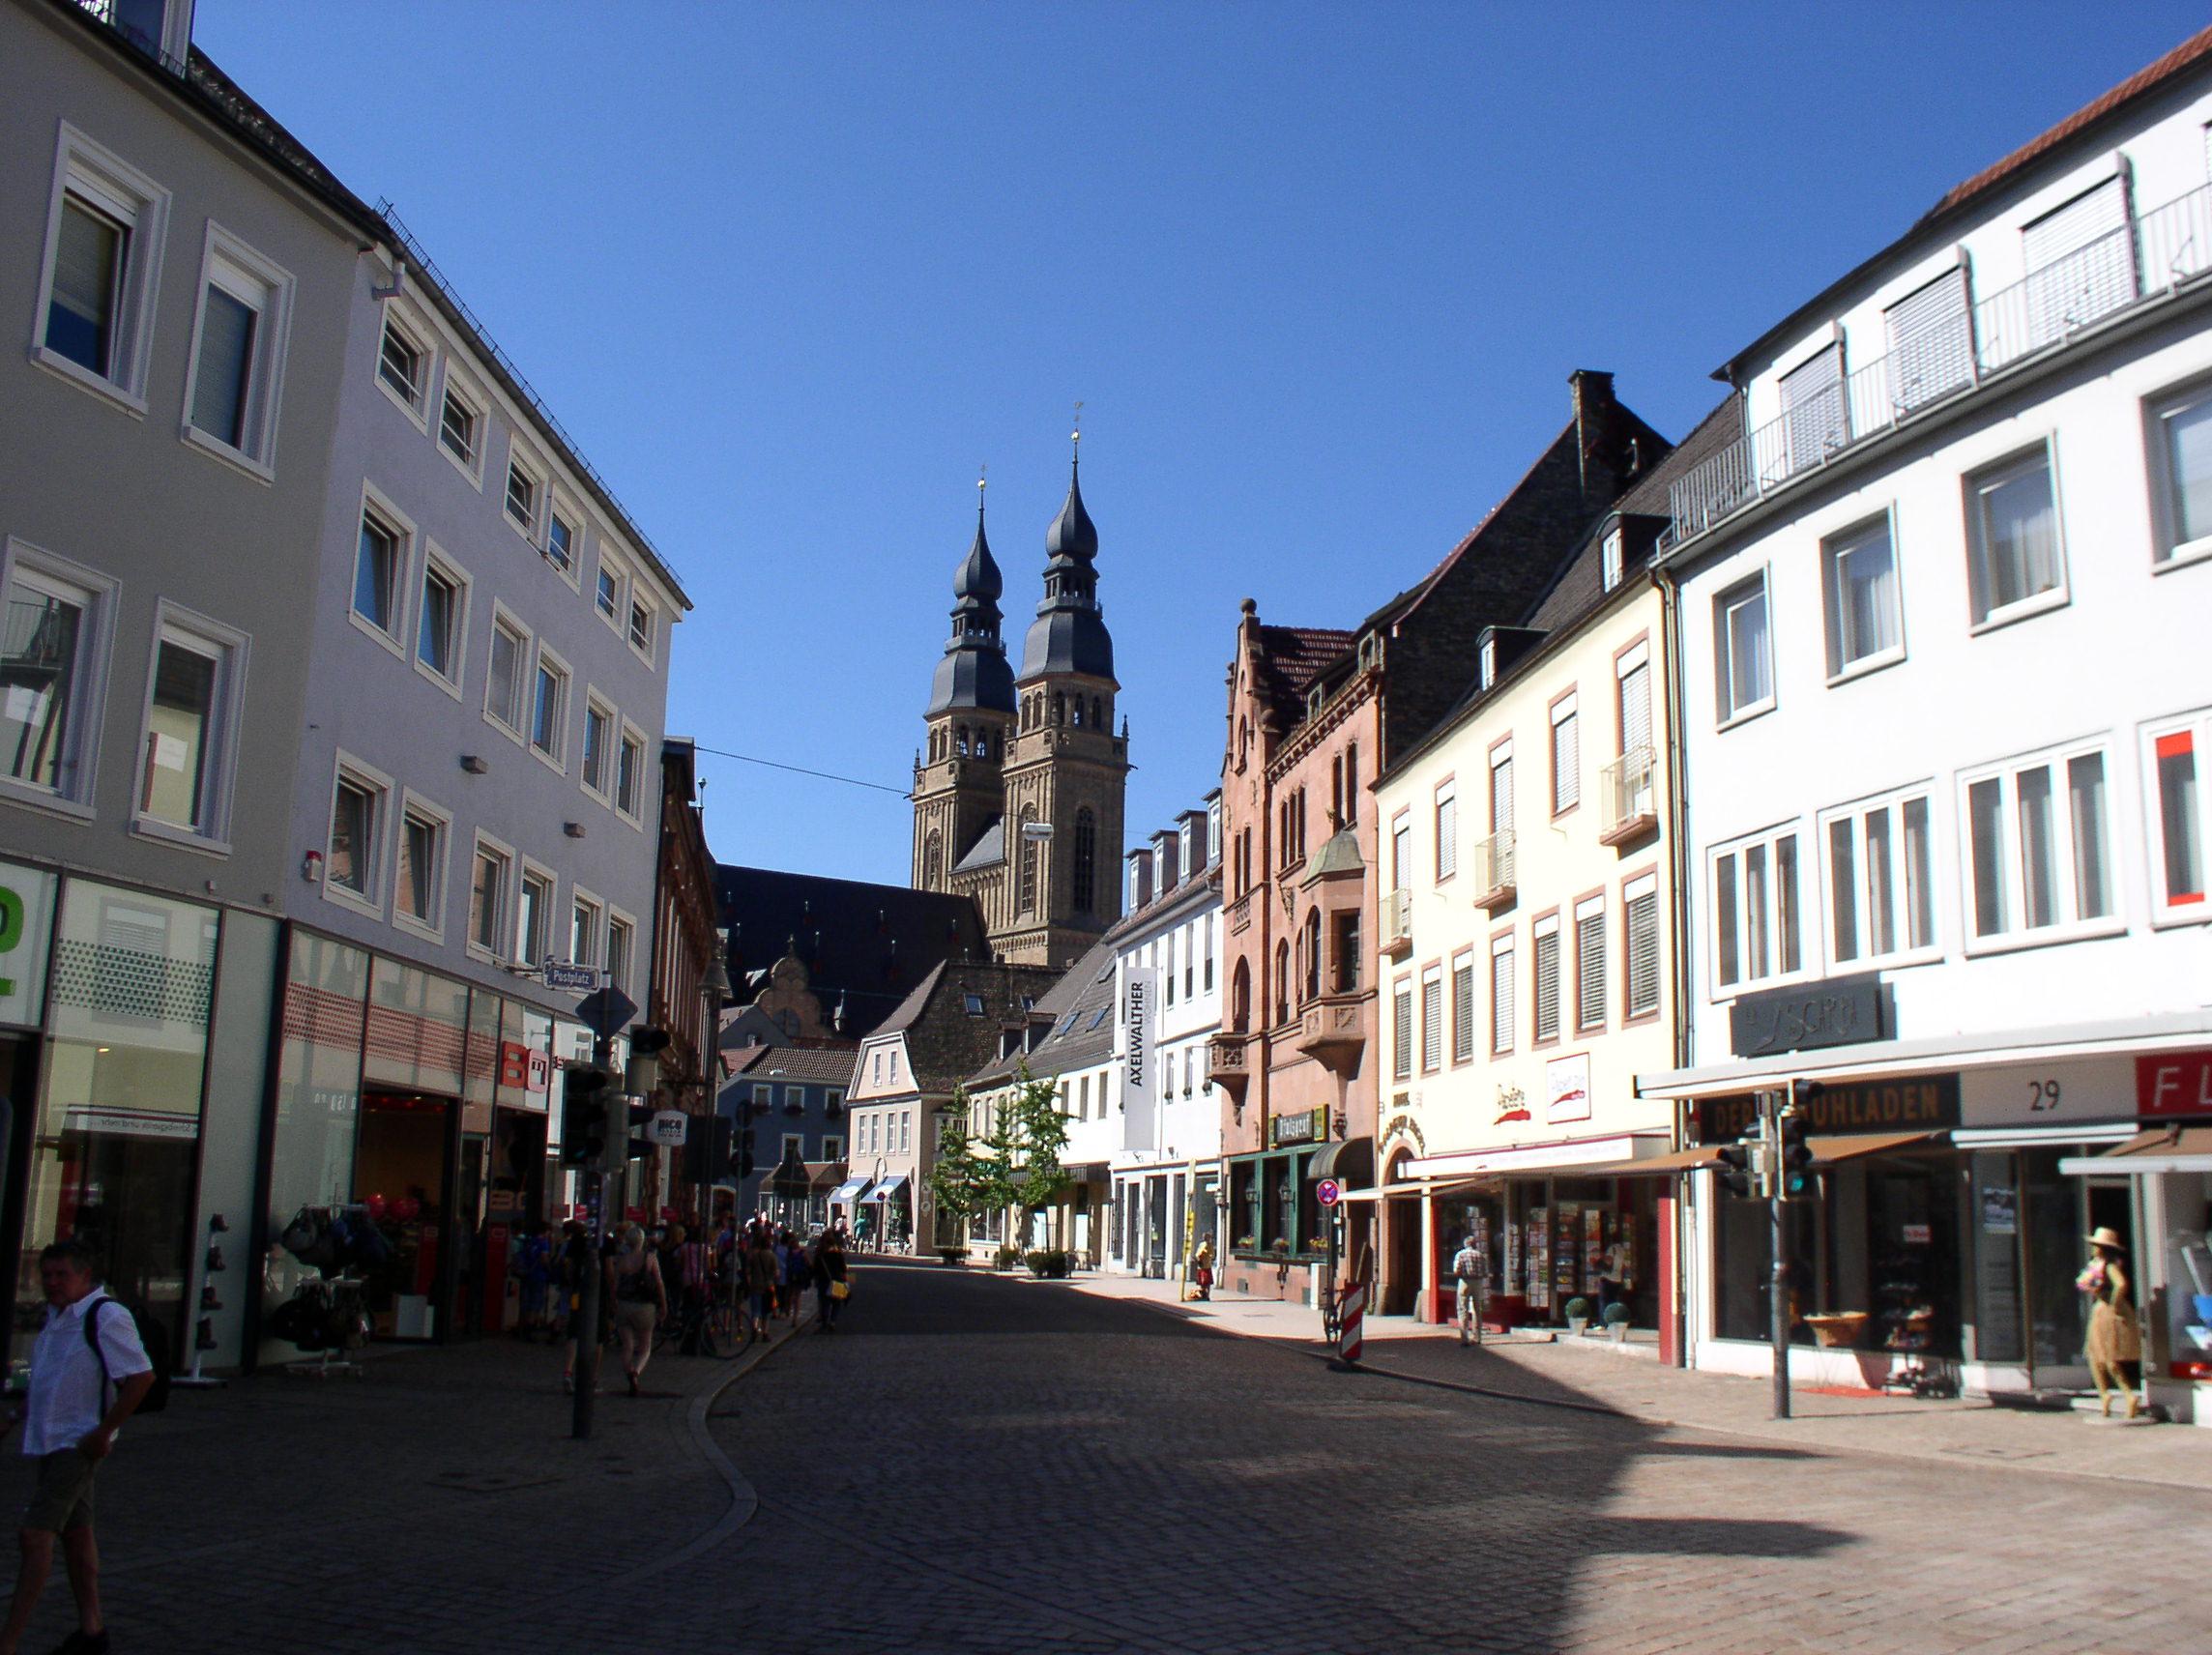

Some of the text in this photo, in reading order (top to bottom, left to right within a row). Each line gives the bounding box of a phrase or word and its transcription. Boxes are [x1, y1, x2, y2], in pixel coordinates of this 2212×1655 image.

[554, 970, 590, 986] Postplatz
[1144, 979, 1153, 1024] WOHNEN
[1130, 981, 1144, 1088] AXELWALTHER
[2027, 1079, 2060, 1112] 29
